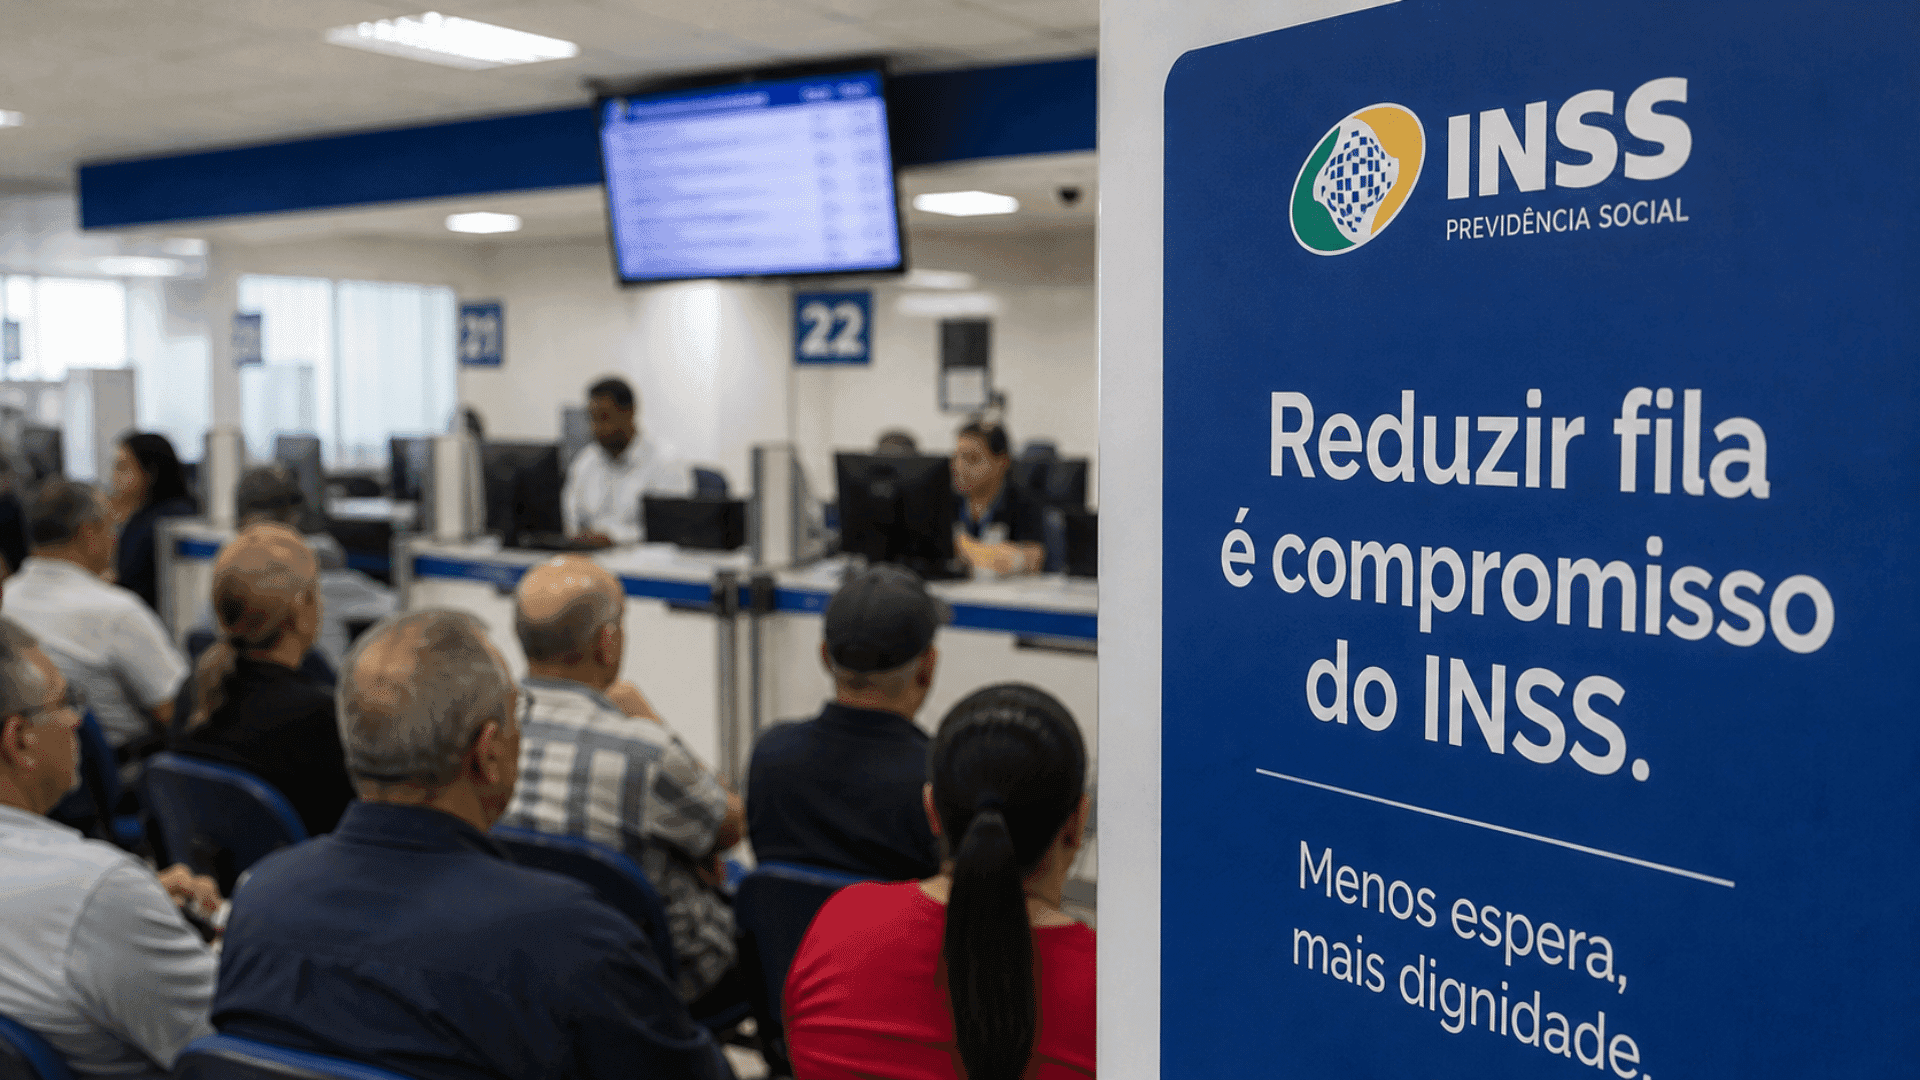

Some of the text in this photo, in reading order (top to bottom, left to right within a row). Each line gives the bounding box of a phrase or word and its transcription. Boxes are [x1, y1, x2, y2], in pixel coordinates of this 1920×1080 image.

[1447, 77, 1692, 200] INSS
[1446, 197, 1690, 241] PREVIDÊNCIA SOCIAL
[801, 303, 863, 356] 22
[1270, 387, 1770, 499] Reduzir fila
[1221, 507, 1834, 654] é compromisso
[1306, 638, 1650, 782] do INSS.
[1293, 928, 1385, 993] mais
[1300, 840, 1627, 994] Menos espera,
